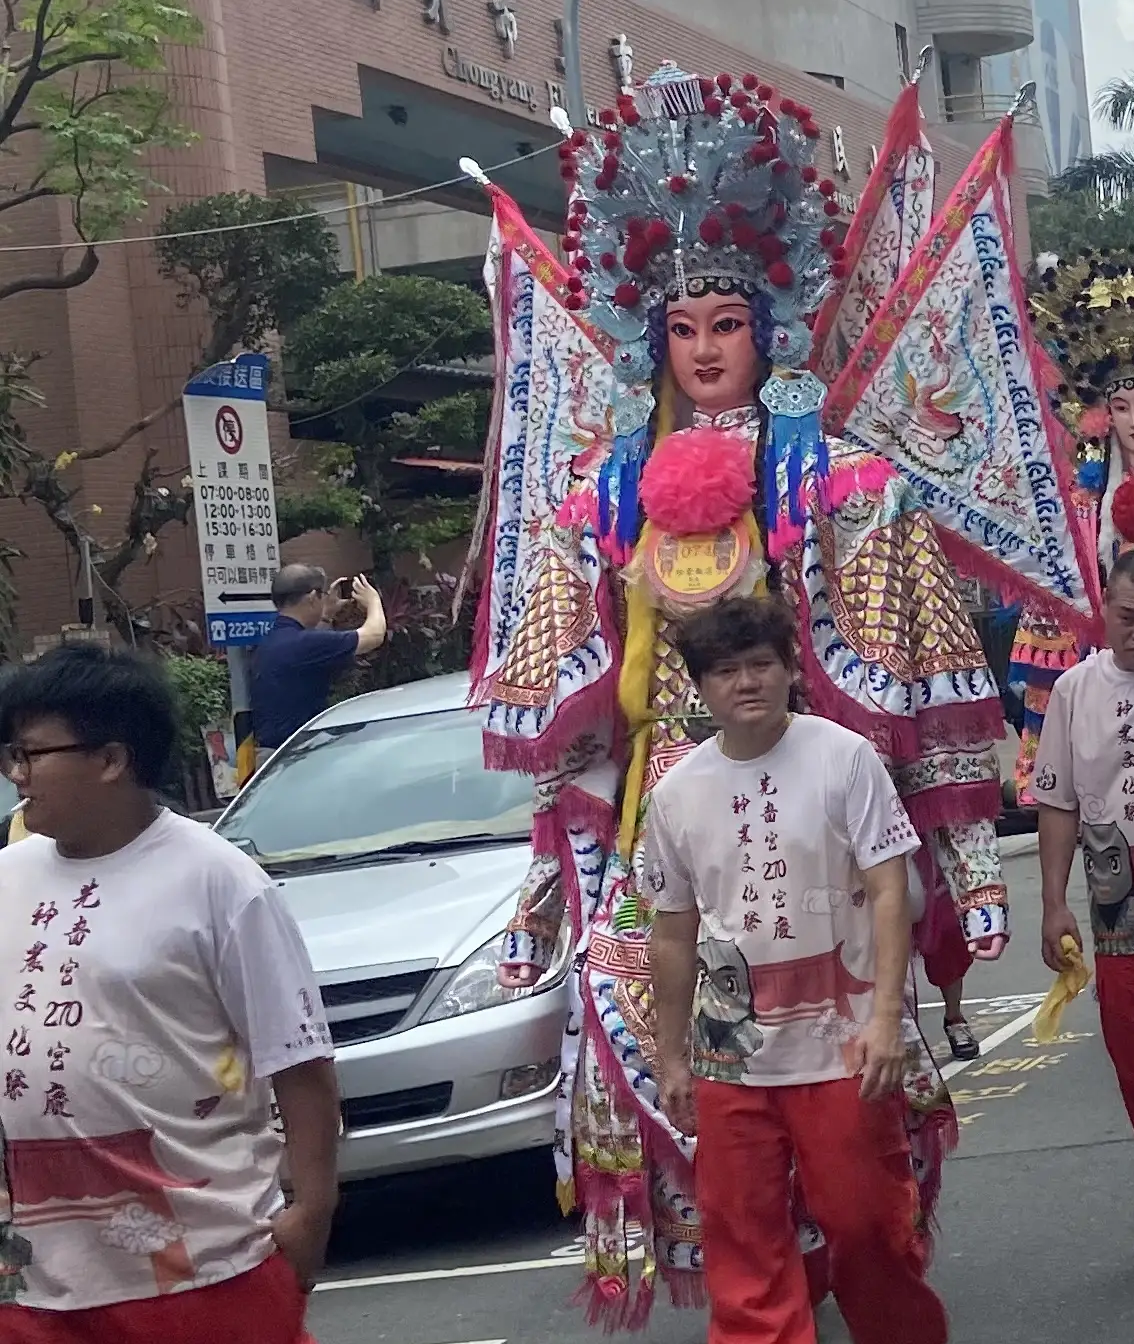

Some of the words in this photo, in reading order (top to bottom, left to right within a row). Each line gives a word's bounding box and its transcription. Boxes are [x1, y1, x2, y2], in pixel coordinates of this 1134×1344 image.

[441, 47, 537, 113] Chongyang
[196, 460, 270, 481] 上課期間
[204, 543, 277, 562] 停車格位
